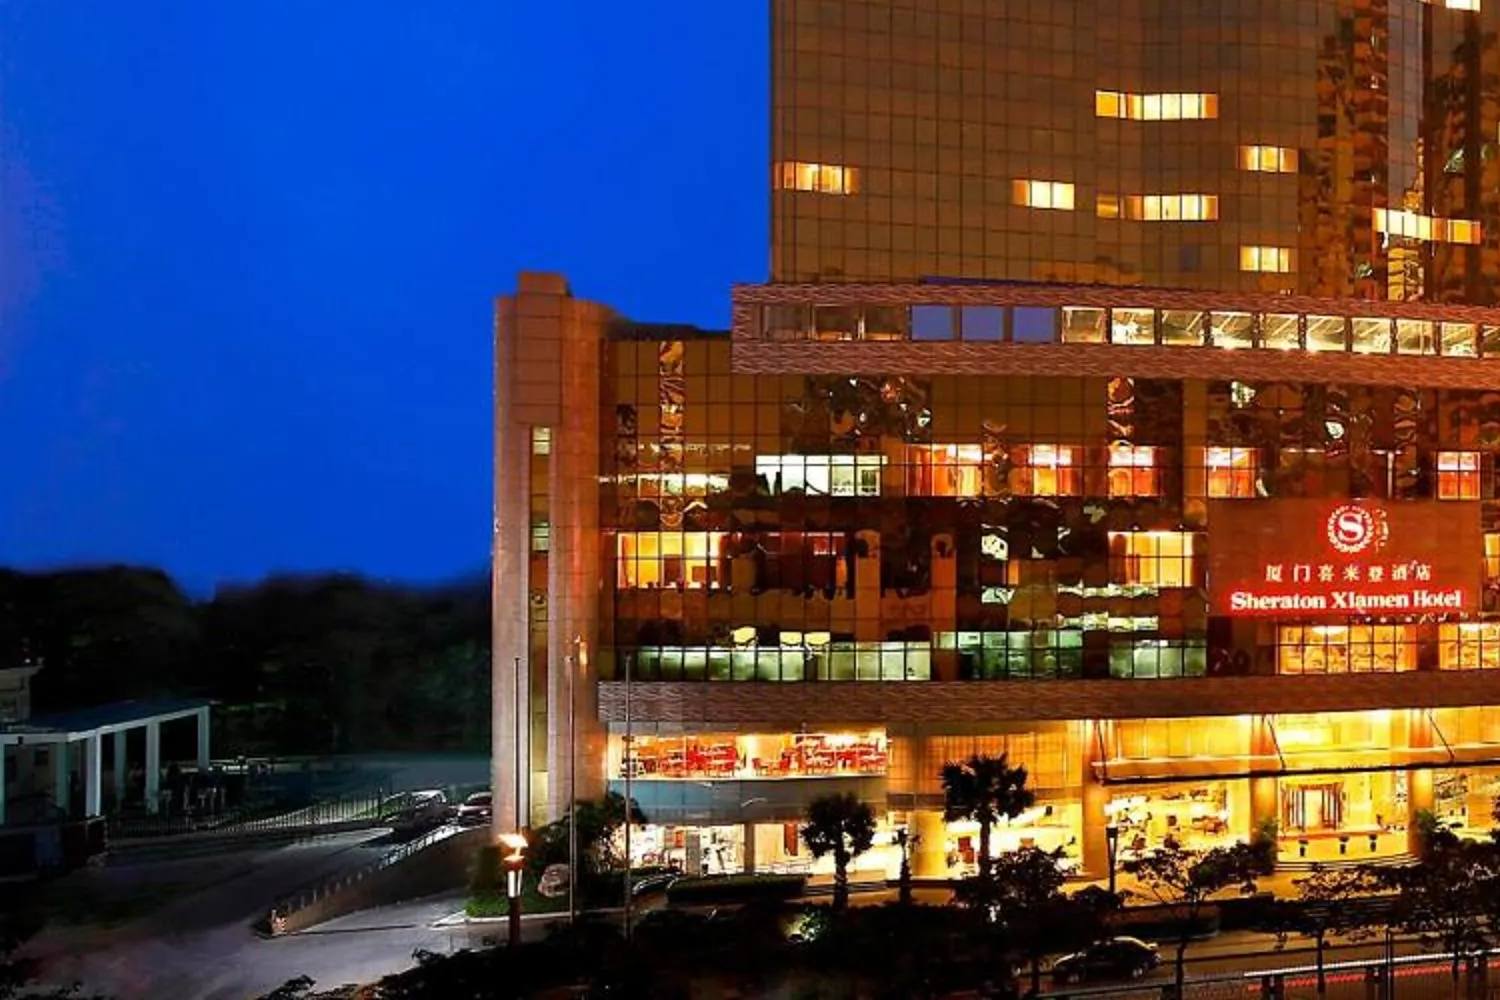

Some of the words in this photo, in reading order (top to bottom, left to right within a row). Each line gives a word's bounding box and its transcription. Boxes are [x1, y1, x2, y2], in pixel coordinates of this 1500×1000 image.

[1338, 512, 1365, 542] S
[1231, 591, 1327, 611] Sheraton
[1331, 590, 1409, 609] Xiamen
[1413, 589, 1461, 608] Hotel
